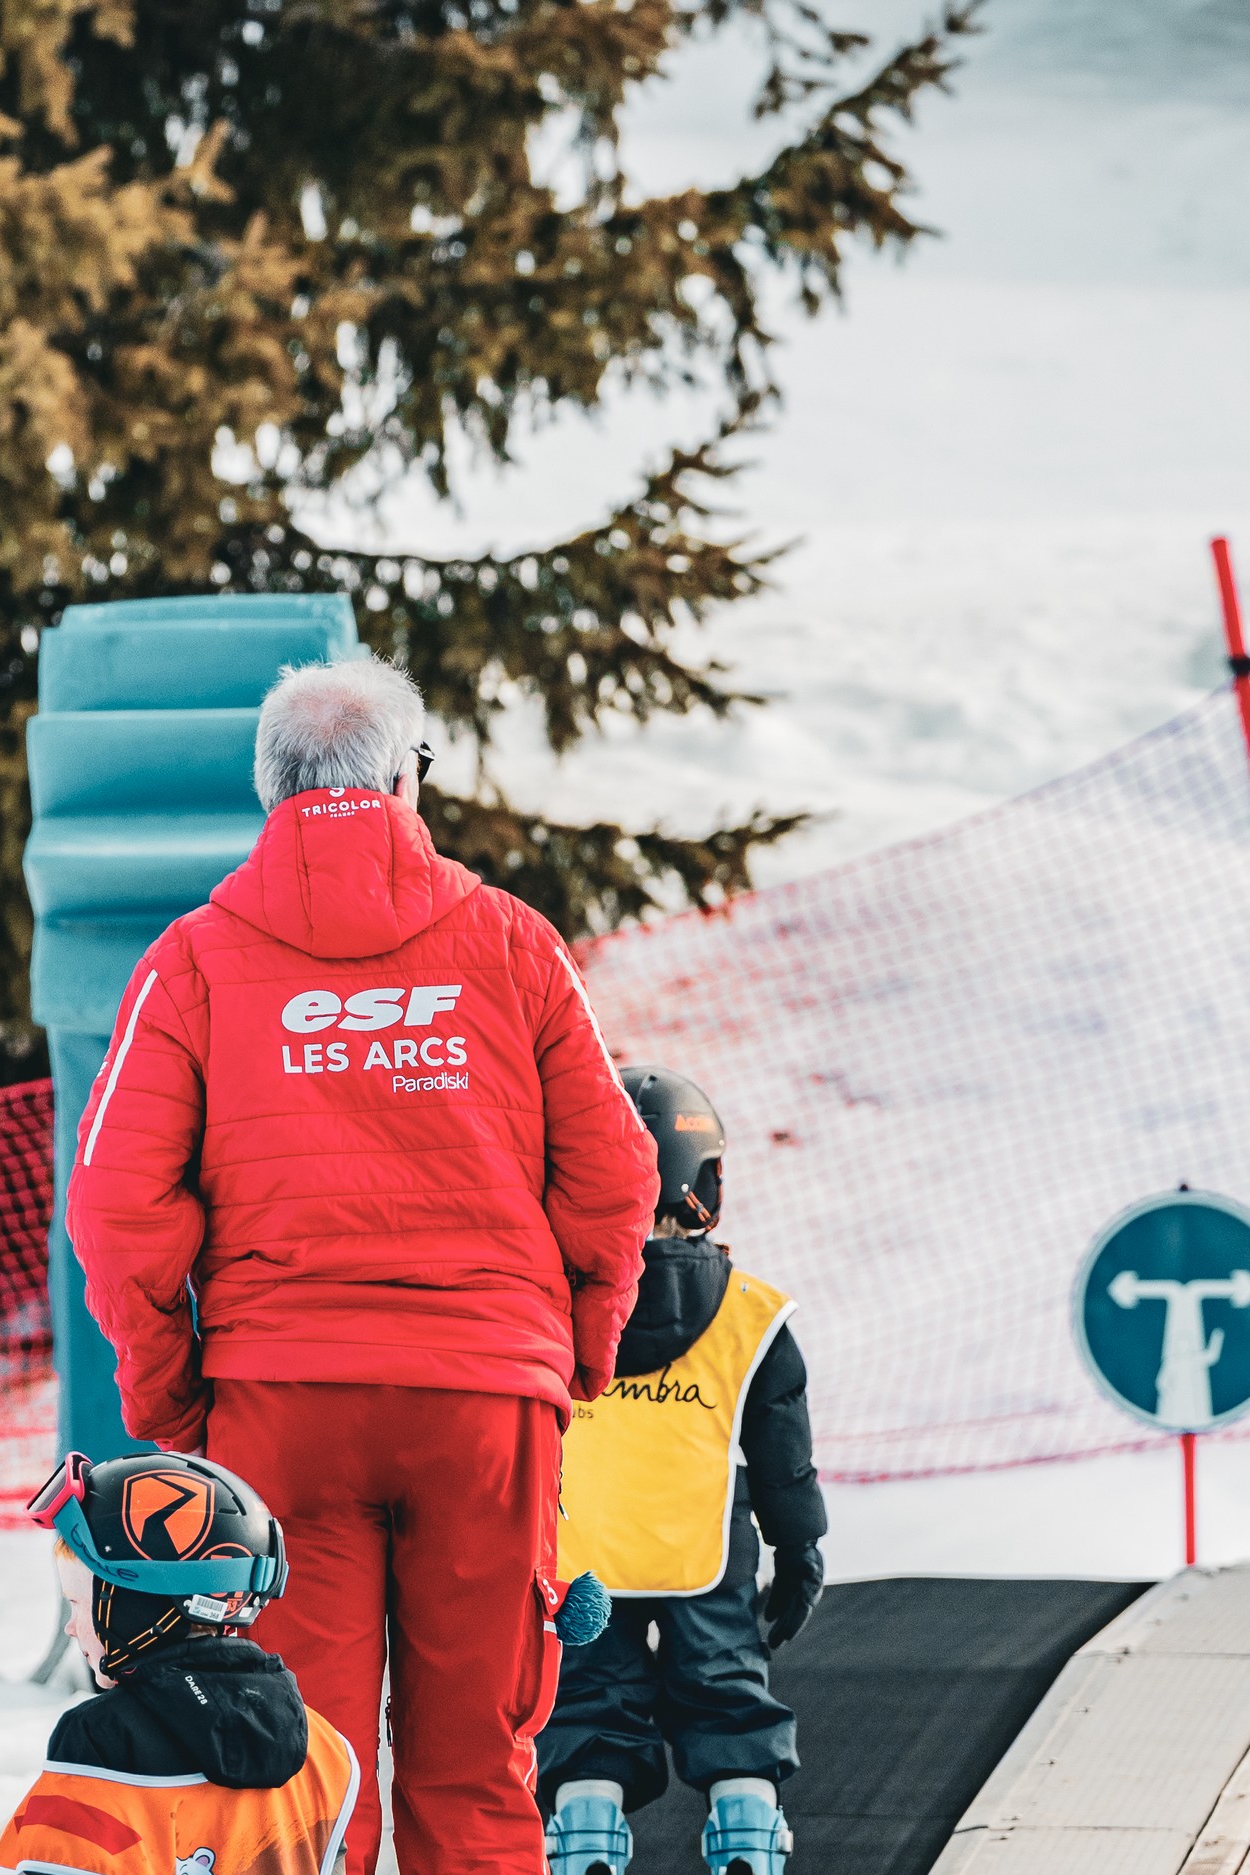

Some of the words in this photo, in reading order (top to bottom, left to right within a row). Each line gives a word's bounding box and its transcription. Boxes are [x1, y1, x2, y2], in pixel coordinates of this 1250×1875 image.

[301, 799, 382, 818] TRICOLOR
[281, 1042, 350, 1074] LES
[362, 1036, 468, 1071] ARCS
[392, 1072, 469, 1093] Paradiski
